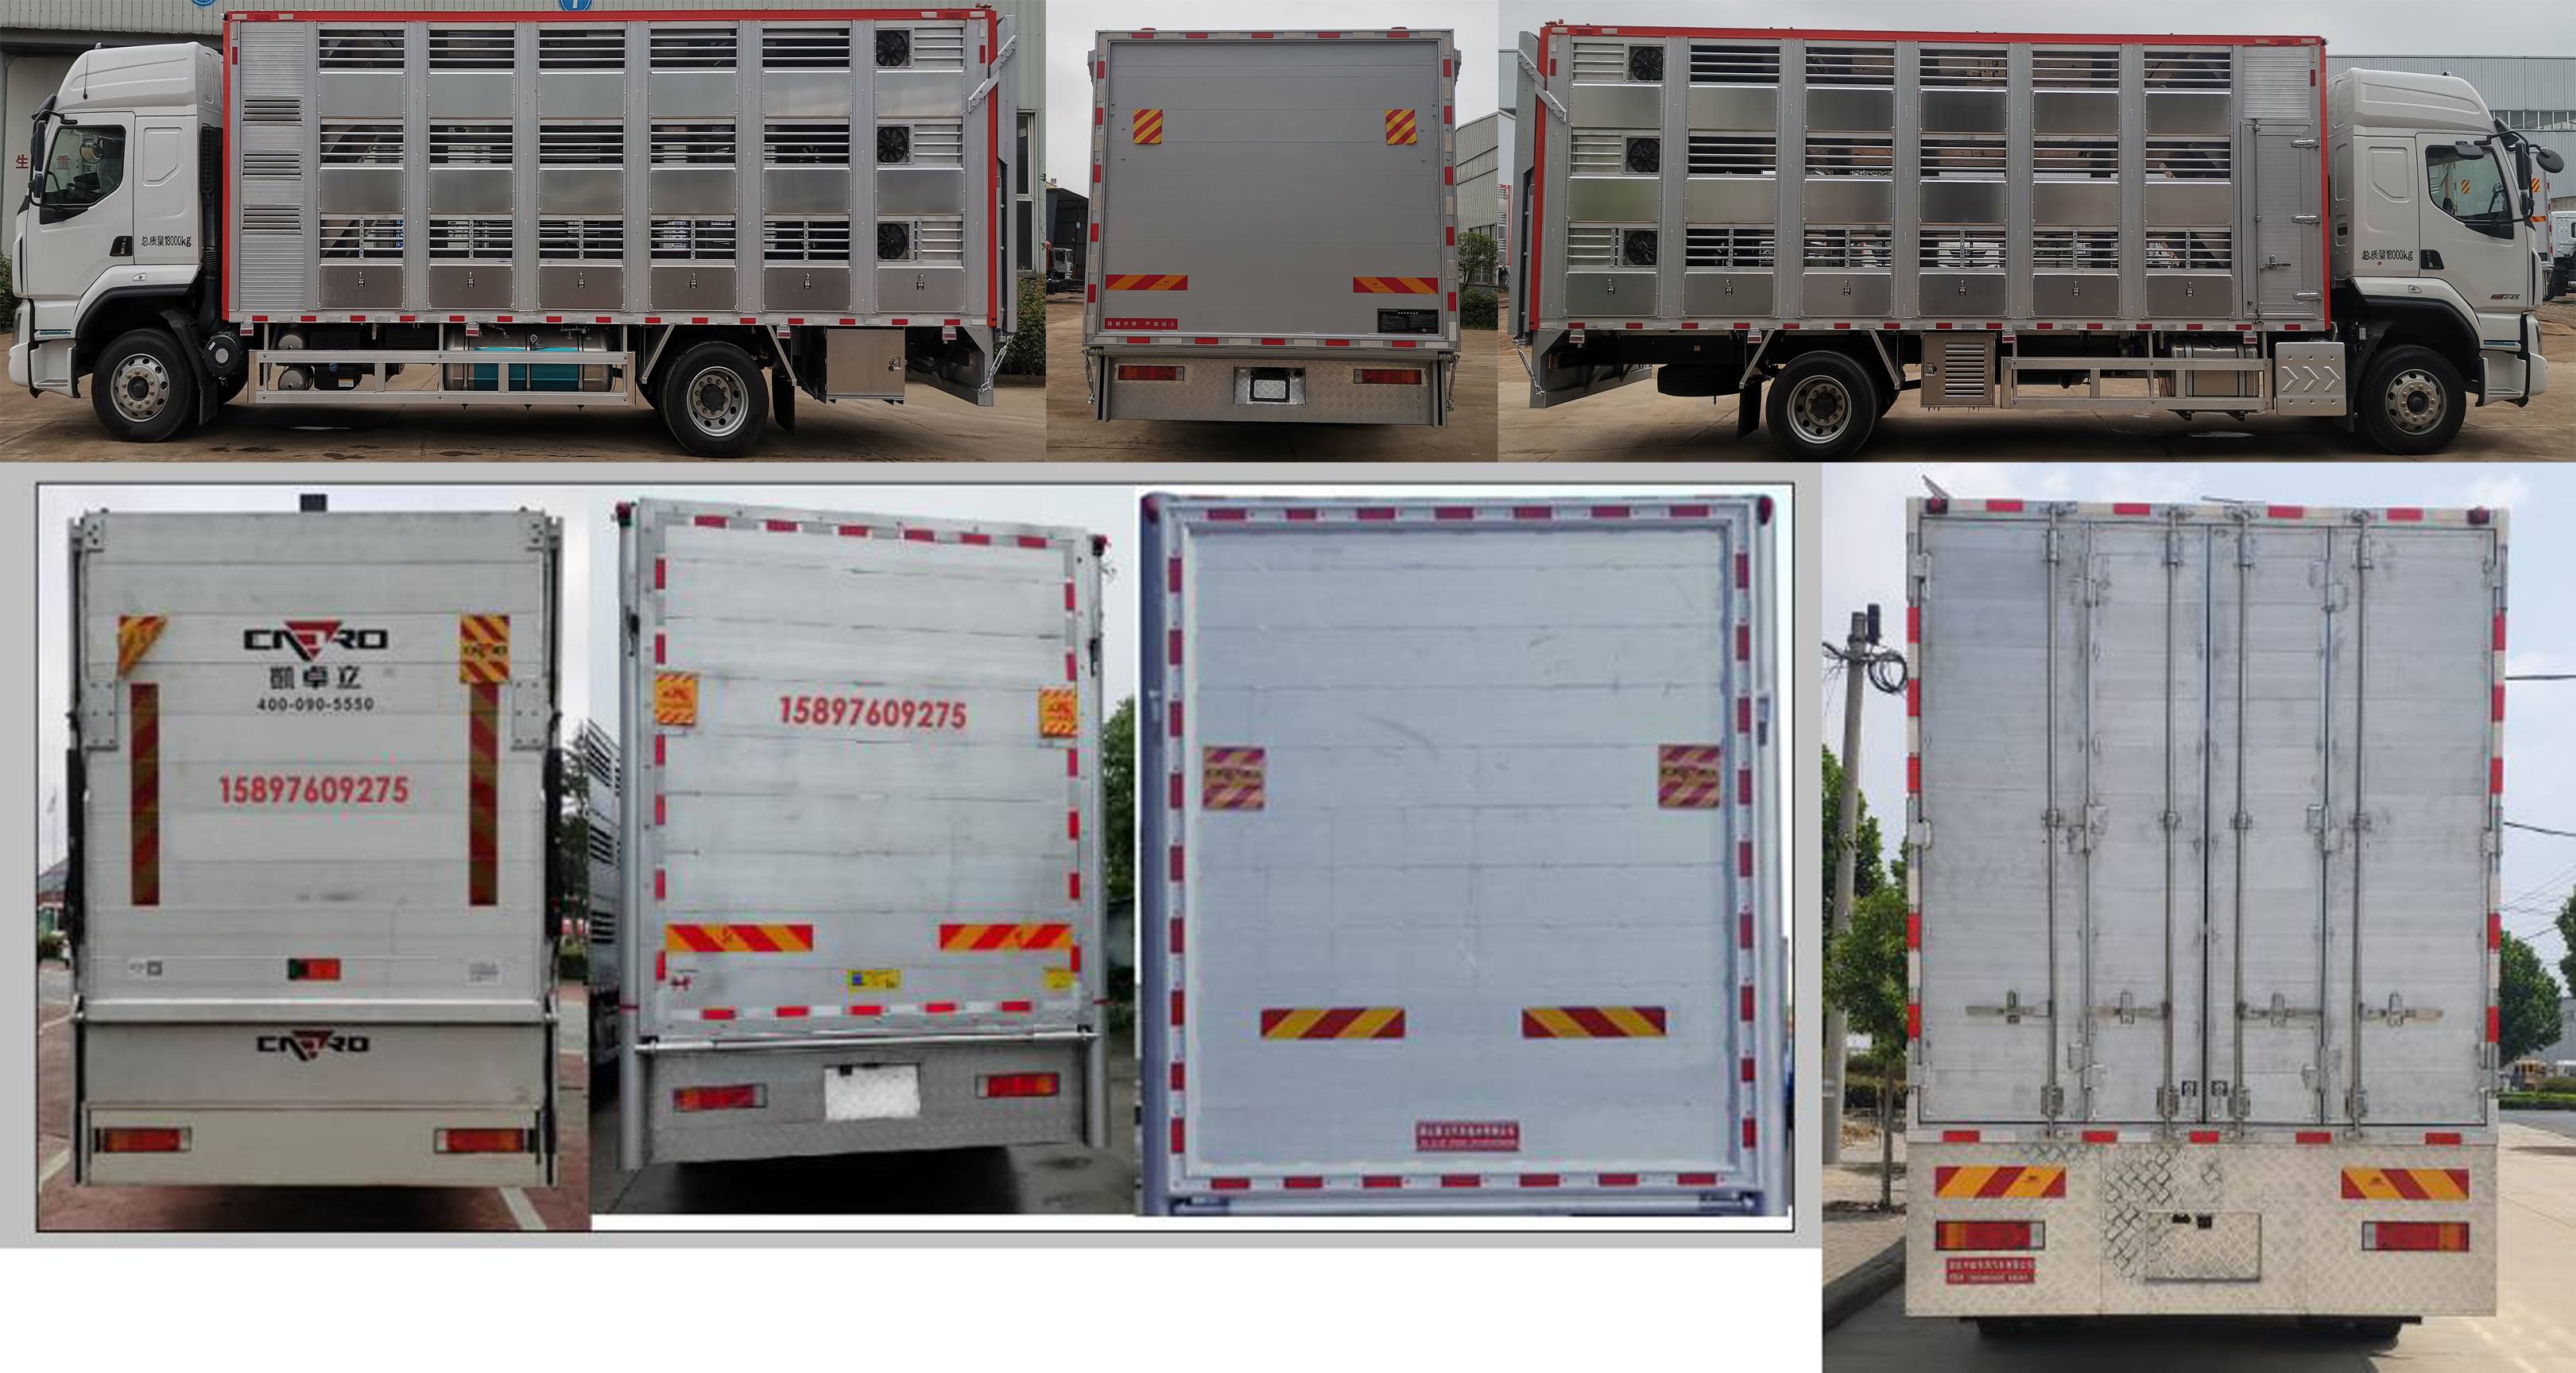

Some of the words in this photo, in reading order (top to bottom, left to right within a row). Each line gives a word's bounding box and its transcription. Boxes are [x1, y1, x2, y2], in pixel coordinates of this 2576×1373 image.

[15, 154, 29, 169] 生
[141, 235, 192, 247] 总质量18000kg
[2361, 249, 2414, 261] 总质量18000kg
[257, 697, 374, 710] 400-090-5550
[779, 695, 966, 729] 15897609275
[219, 775, 409, 803] 15897609275
